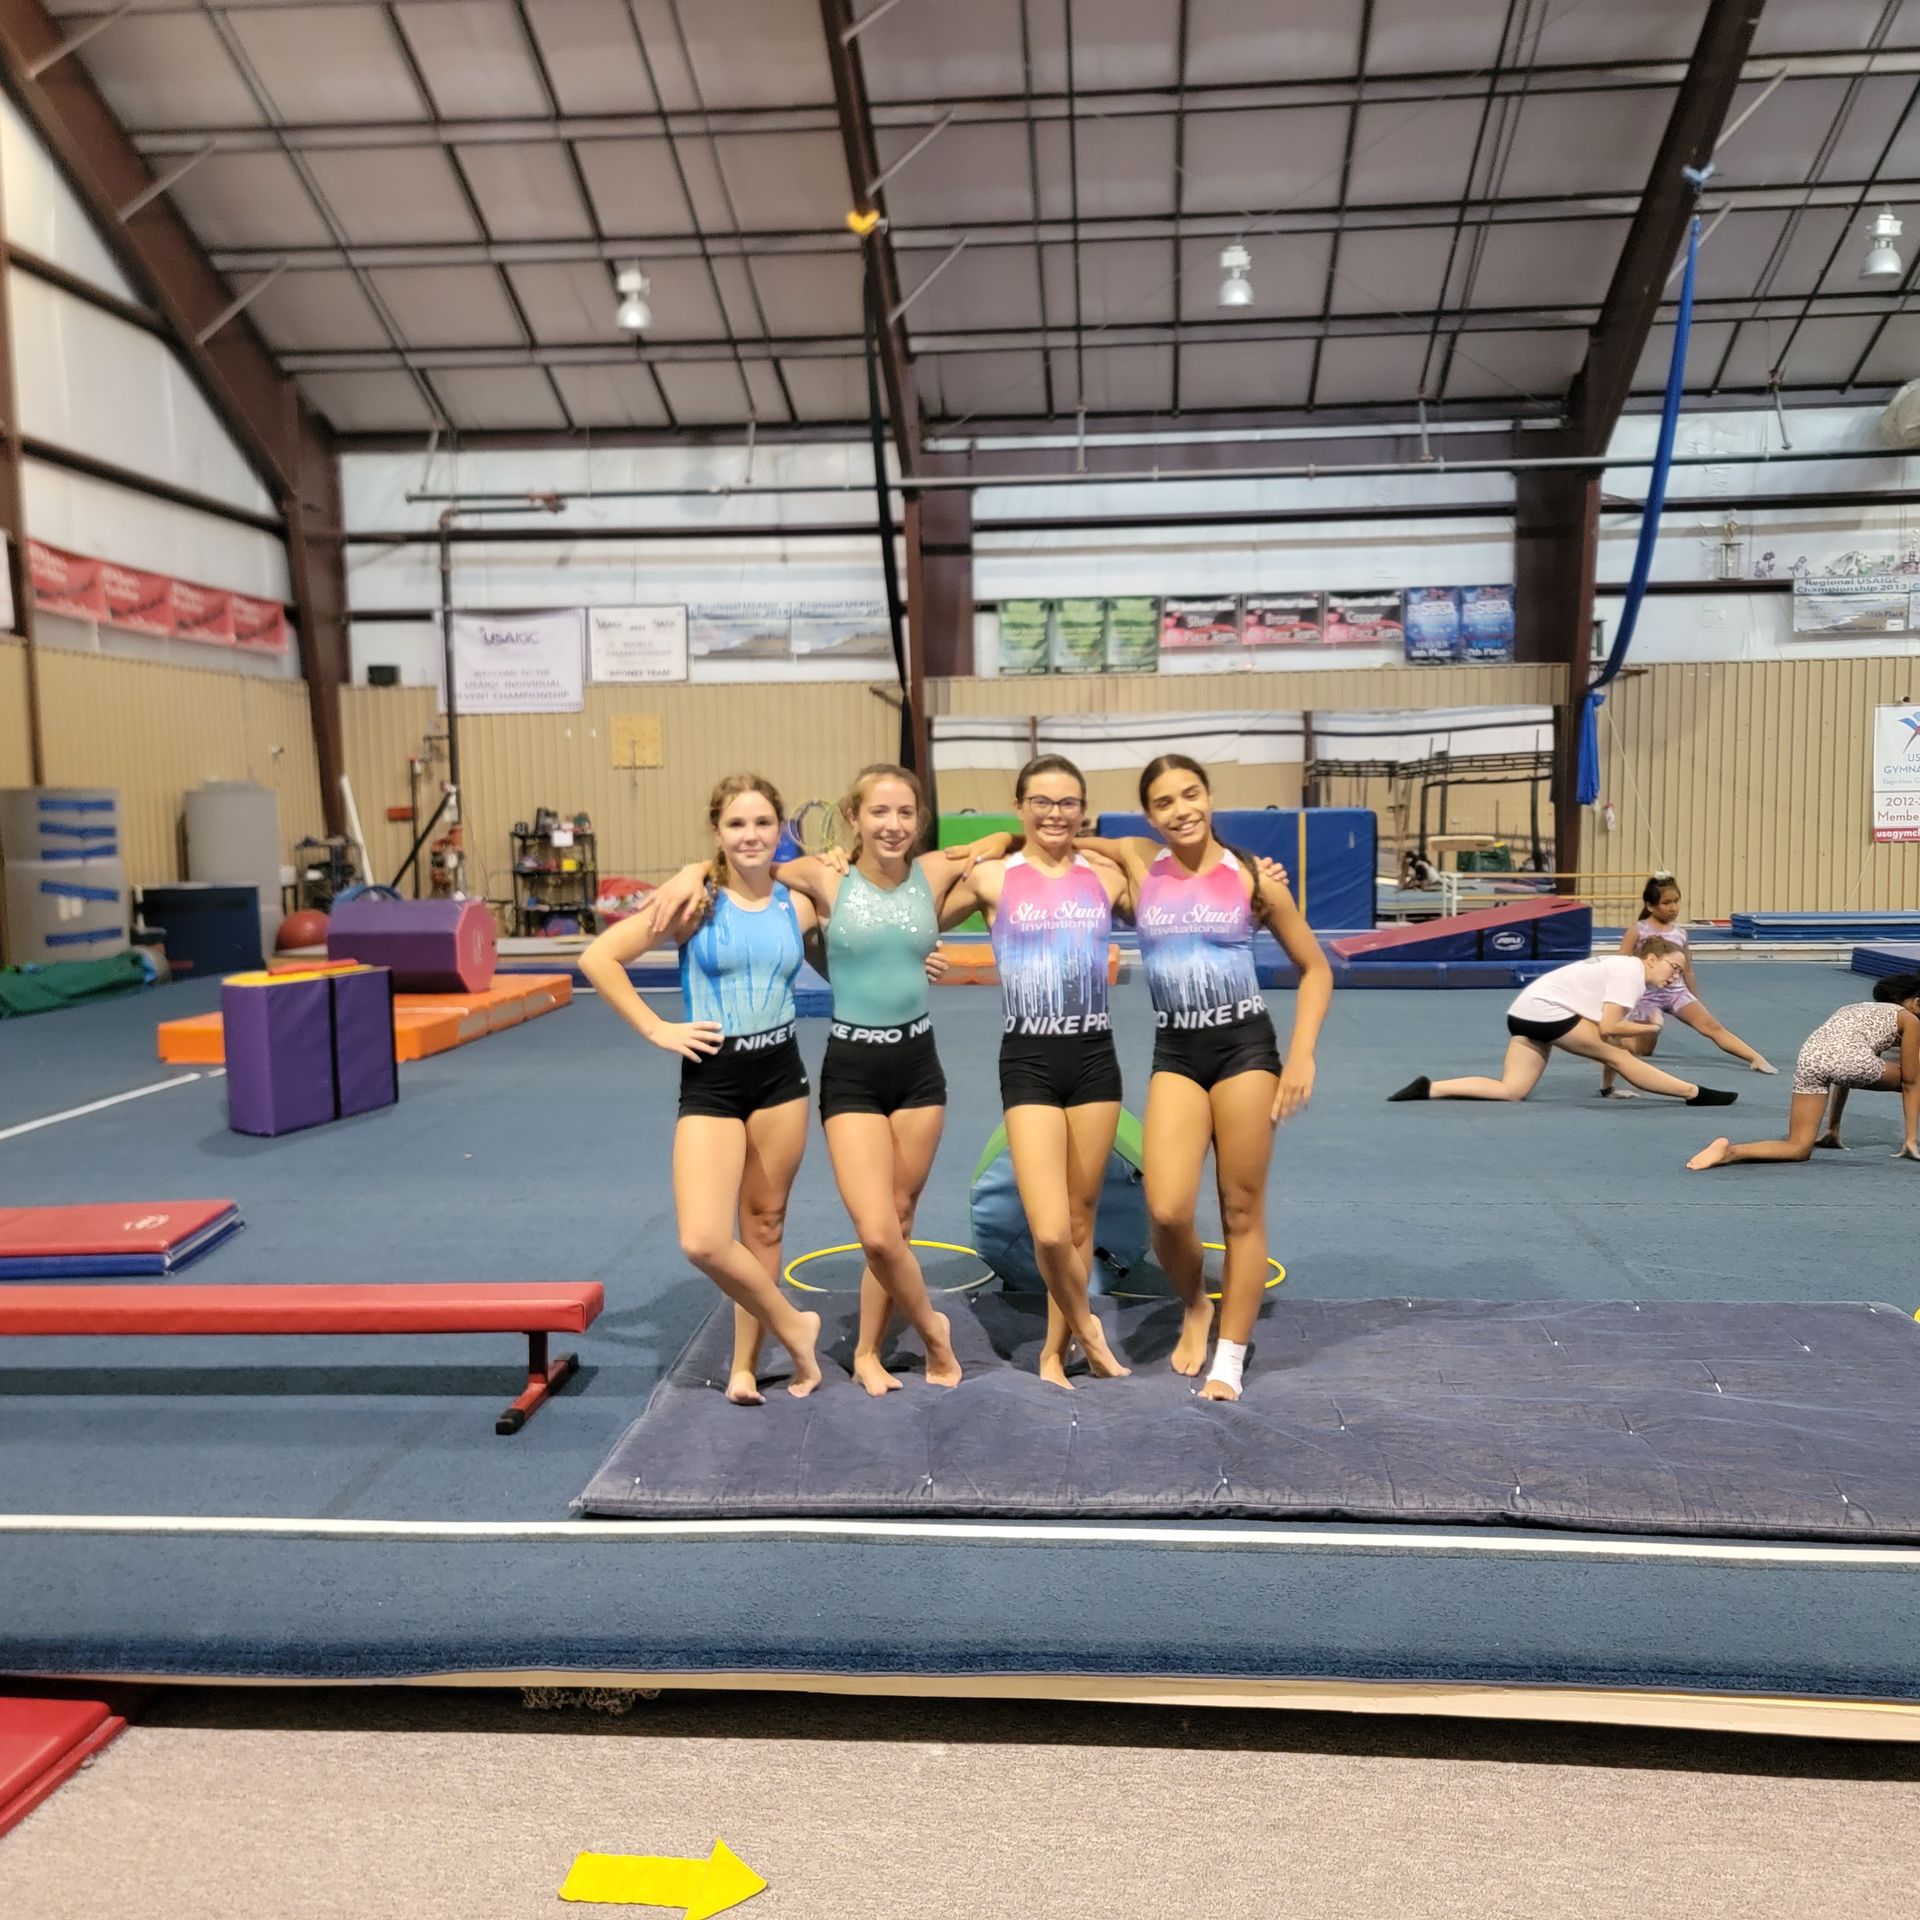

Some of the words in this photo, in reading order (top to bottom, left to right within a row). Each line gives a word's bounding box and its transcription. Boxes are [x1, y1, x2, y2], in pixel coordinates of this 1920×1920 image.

[1796, 585, 1878, 594] Championship
[1880, 583, 1908, 591] 2013
[1805, 578, 1854, 587] Regional
[1857, 577, 1900, 585] USAIGC
[1009, 902, 1051, 925] Star
[1054, 899, 1107, 921] Struck
[1138, 905, 1177, 928] Star
[1182, 903, 1242, 925] Struck
[1021, 917, 1099, 932] Invitational
[1149, 921, 1230, 936] Invitational
[1174, 1004, 1232, 1029] NIKE
[1238, 995, 1267, 1019] PR
[1020, 1015, 1081, 1035] NIKE
[734, 1026, 788, 1052] NIKE
[851, 1027, 903, 1044] PRO
